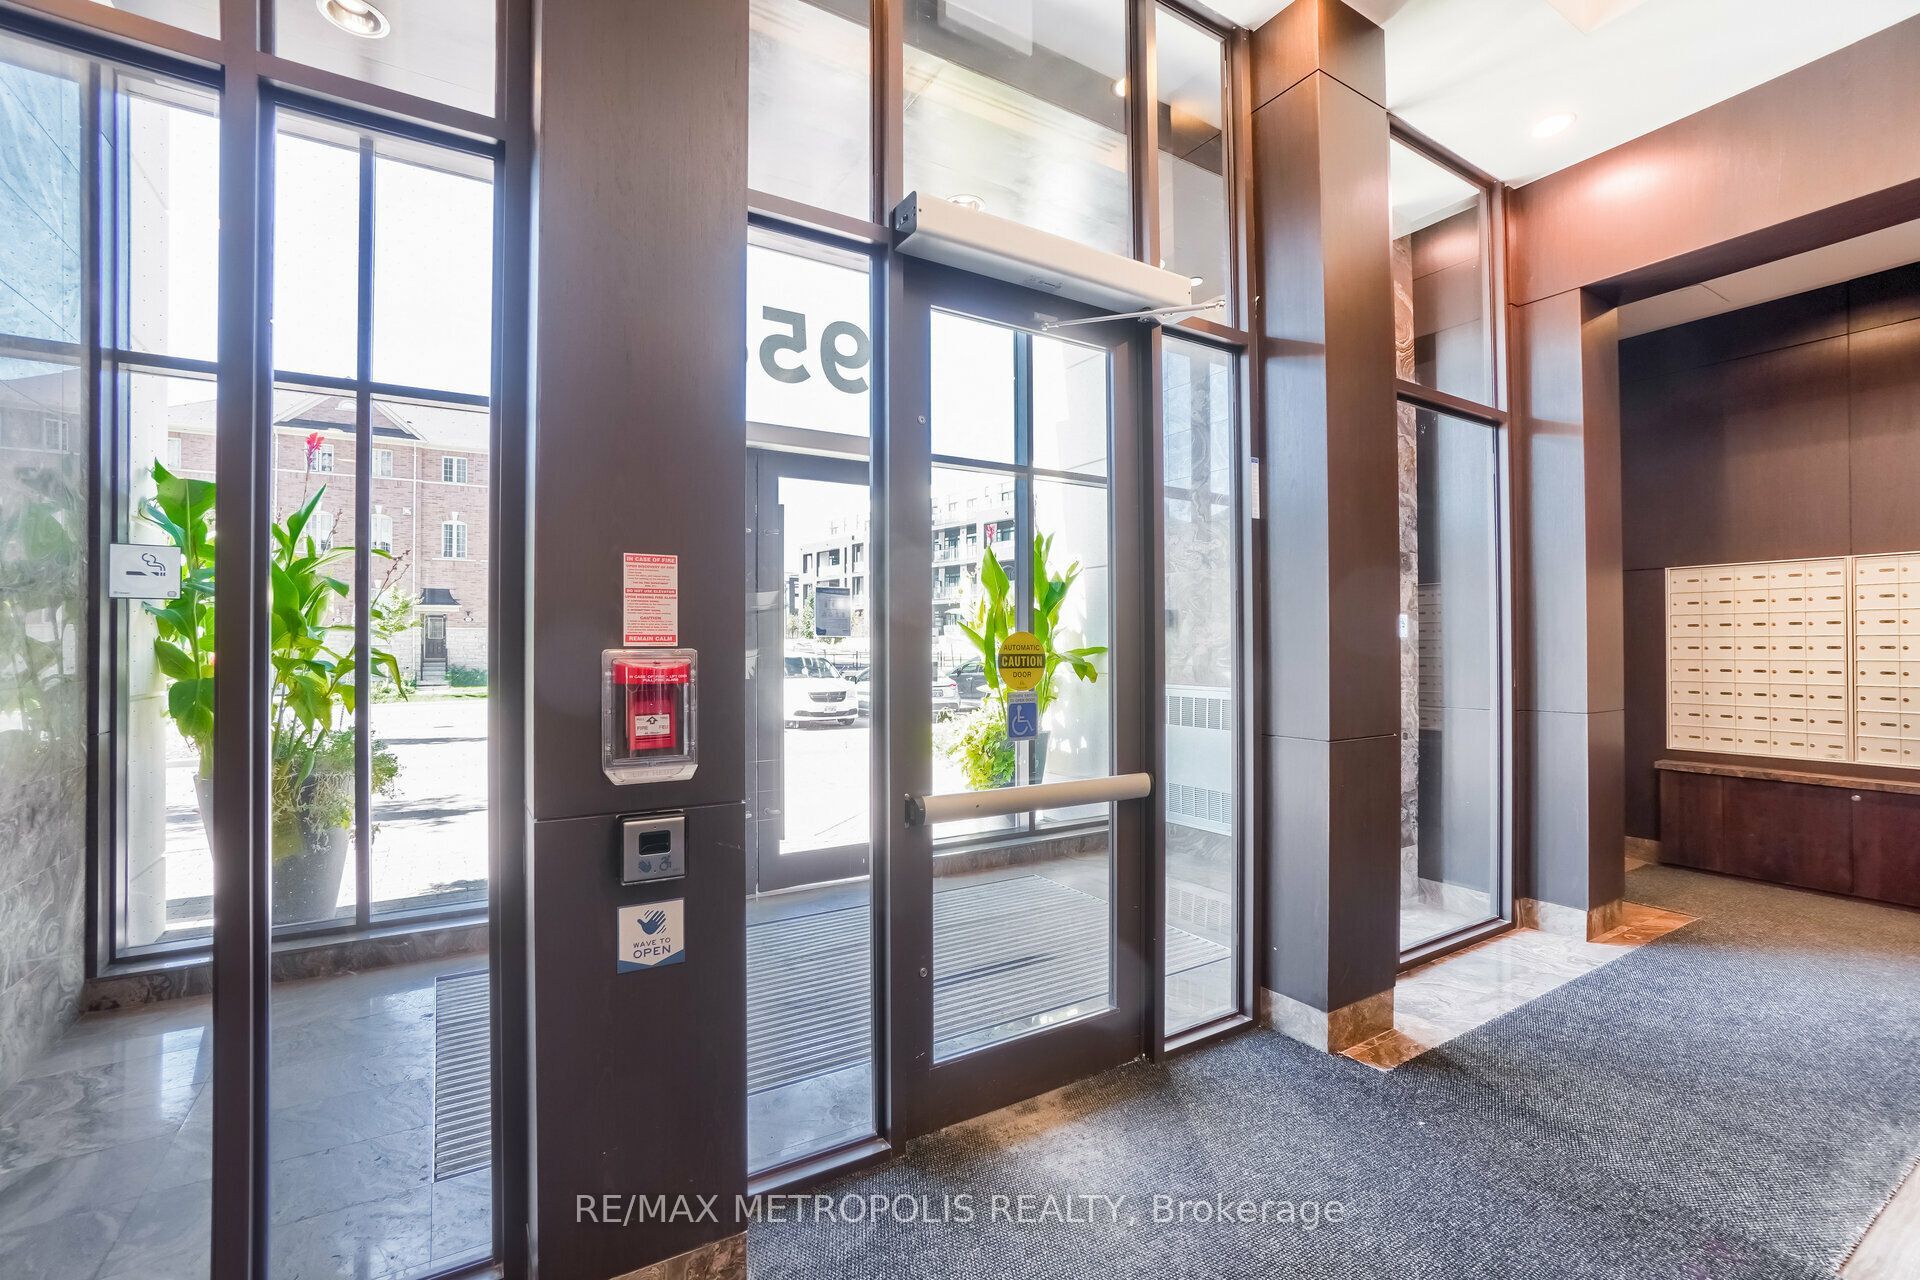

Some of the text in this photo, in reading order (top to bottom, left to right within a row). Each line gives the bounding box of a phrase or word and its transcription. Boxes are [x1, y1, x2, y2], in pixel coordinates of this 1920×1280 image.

[1001, 655, 1043, 667] CAUTION
[633, 939, 657, 948] WAVE
[633, 944, 671, 959] OPEN
